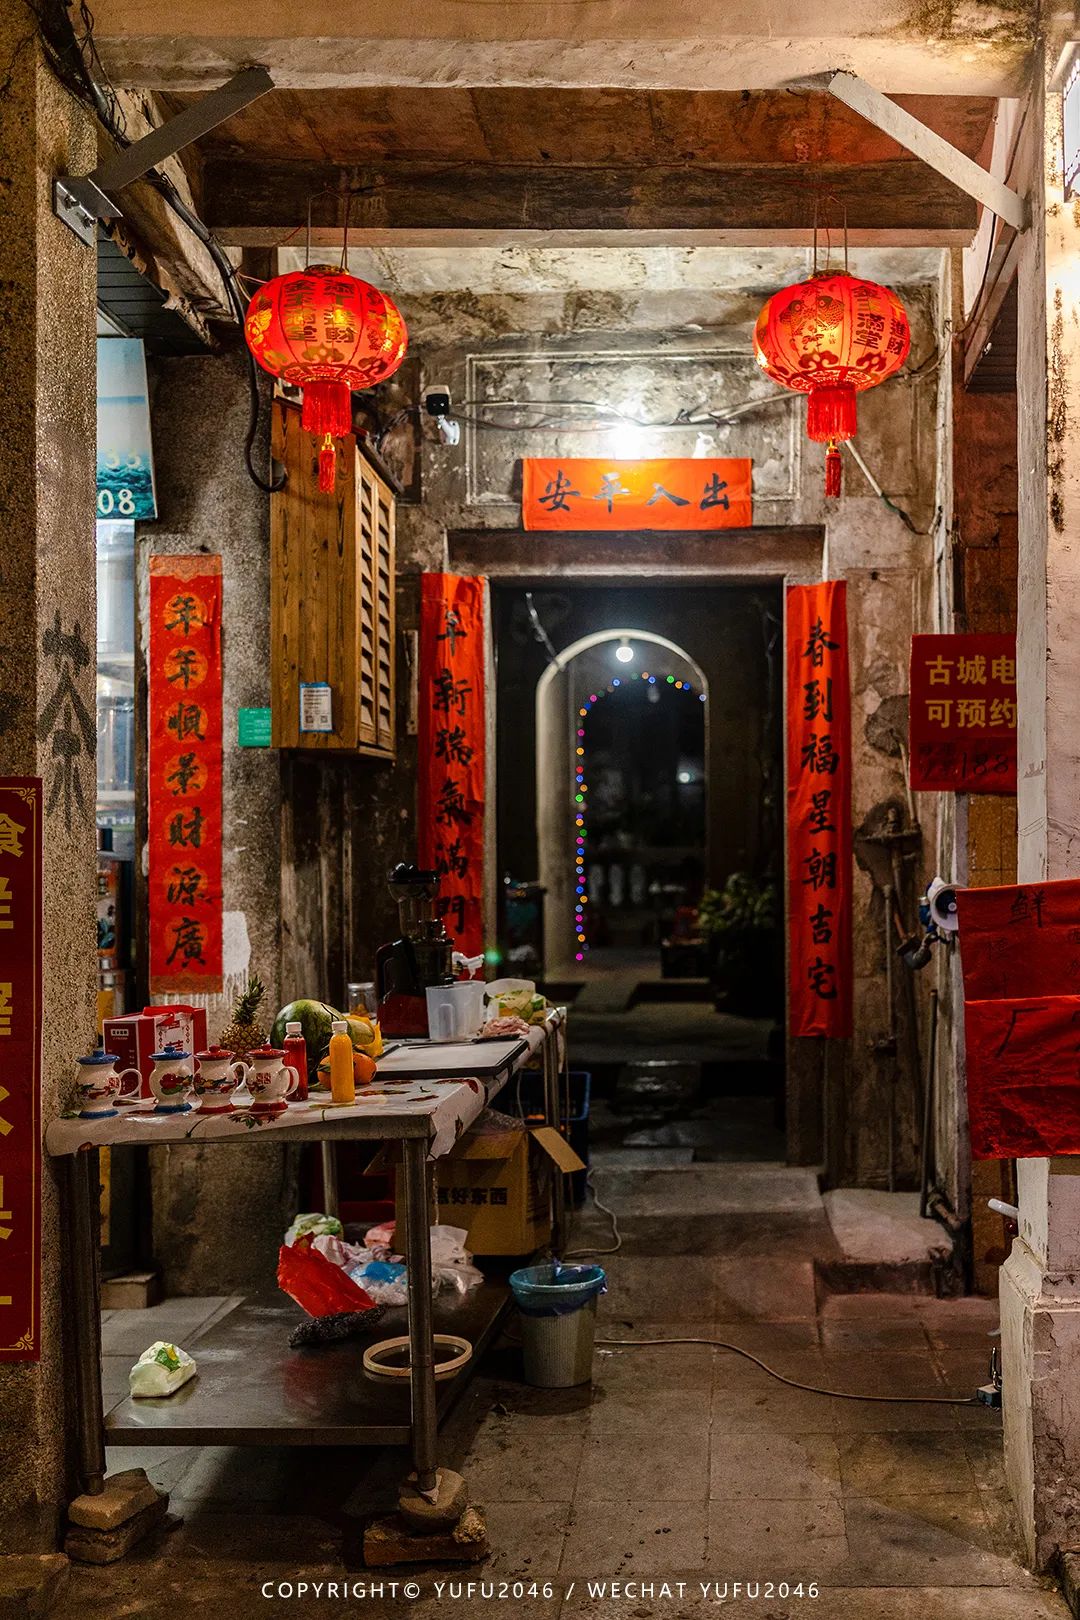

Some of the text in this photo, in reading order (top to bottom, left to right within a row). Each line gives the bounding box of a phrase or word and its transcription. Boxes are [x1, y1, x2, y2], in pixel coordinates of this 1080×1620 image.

[925, 655, 1016, 686] 古城电
[925, 698, 1017, 728] 可预约
[801, 616, 840, 1000] 春到福星朝吉宅
